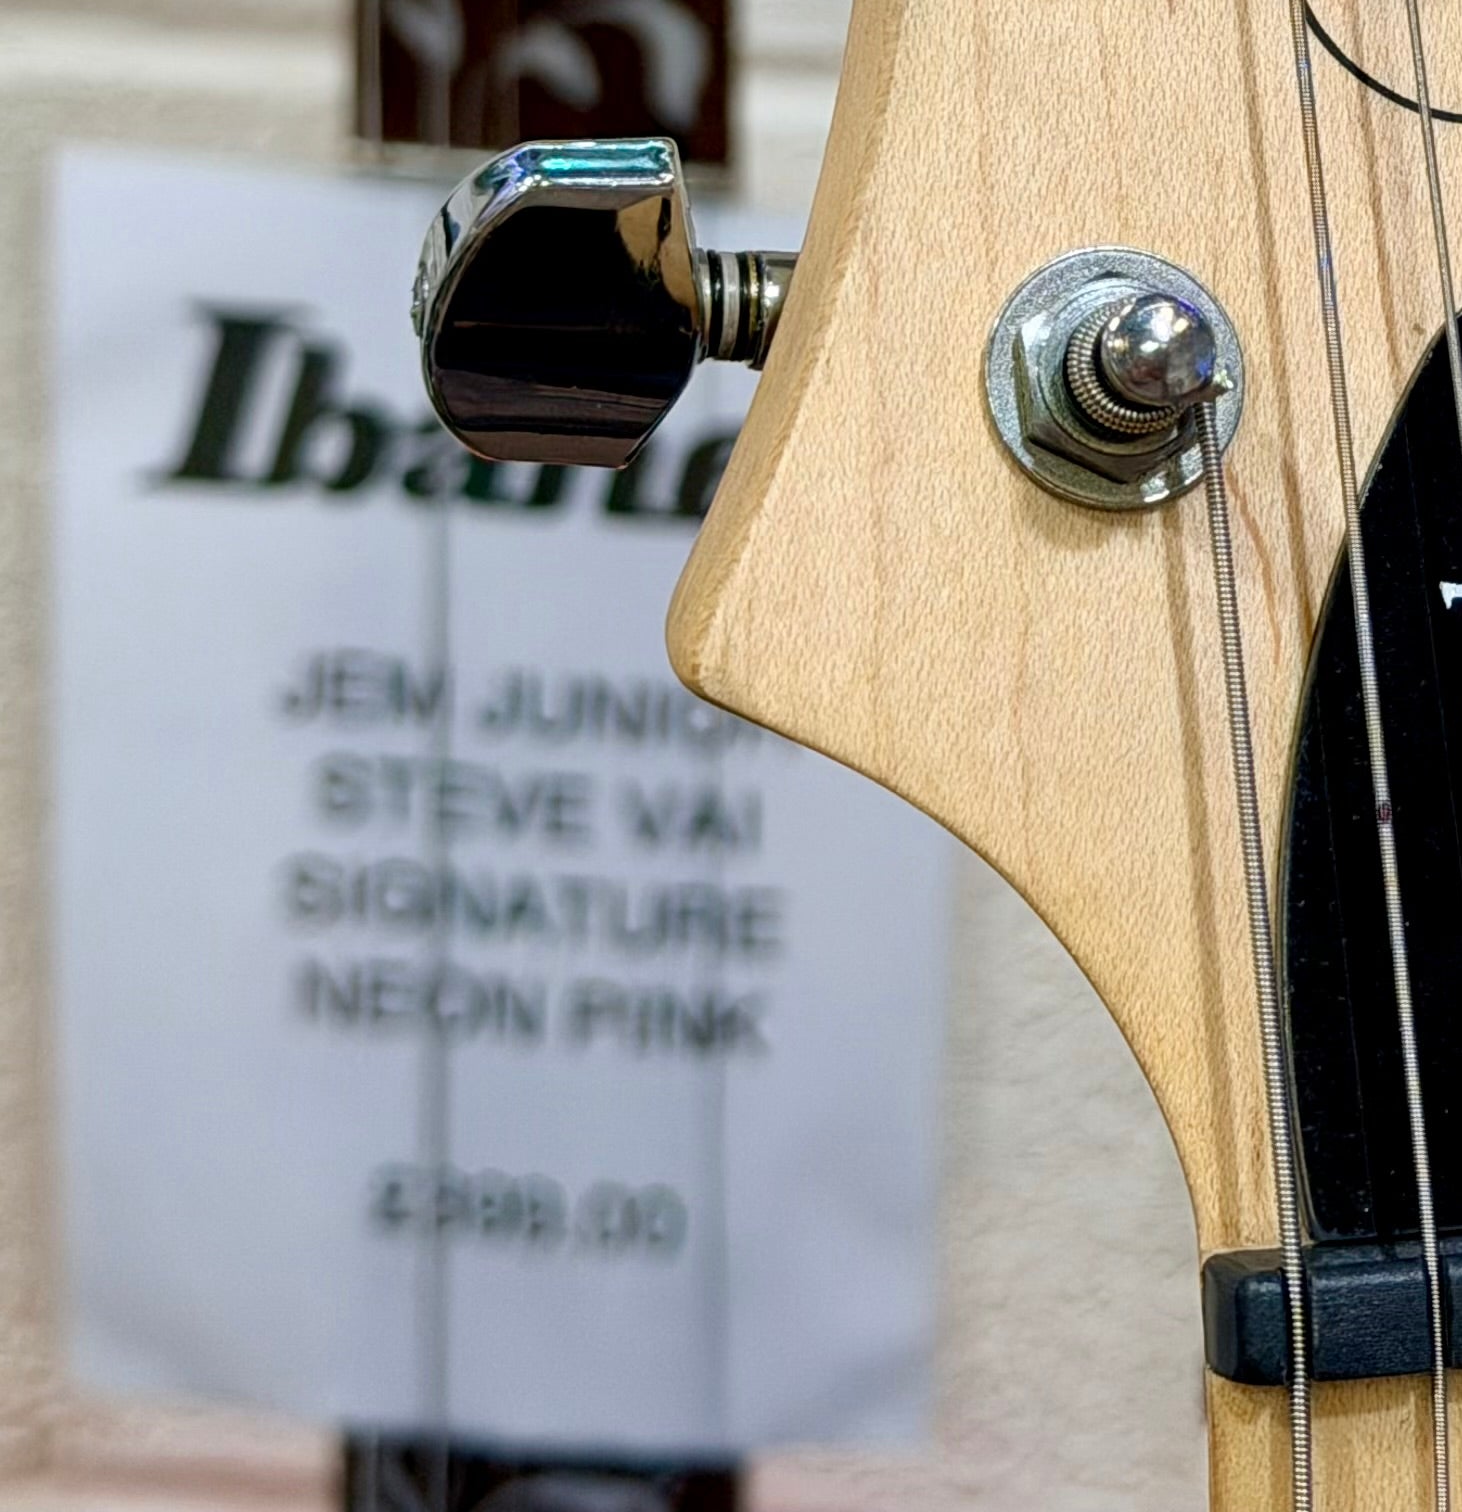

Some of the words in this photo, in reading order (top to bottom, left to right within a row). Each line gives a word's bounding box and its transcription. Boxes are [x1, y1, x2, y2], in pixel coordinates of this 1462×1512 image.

[280, 648, 447, 724] JEM
[313, 751, 592, 850] STEVE
[621, 774, 765, 854] VAI
[281, 852, 788, 961] SIGNATURE
[295, 956, 548, 1045] NEON
[565, 976, 770, 1058] PINK
